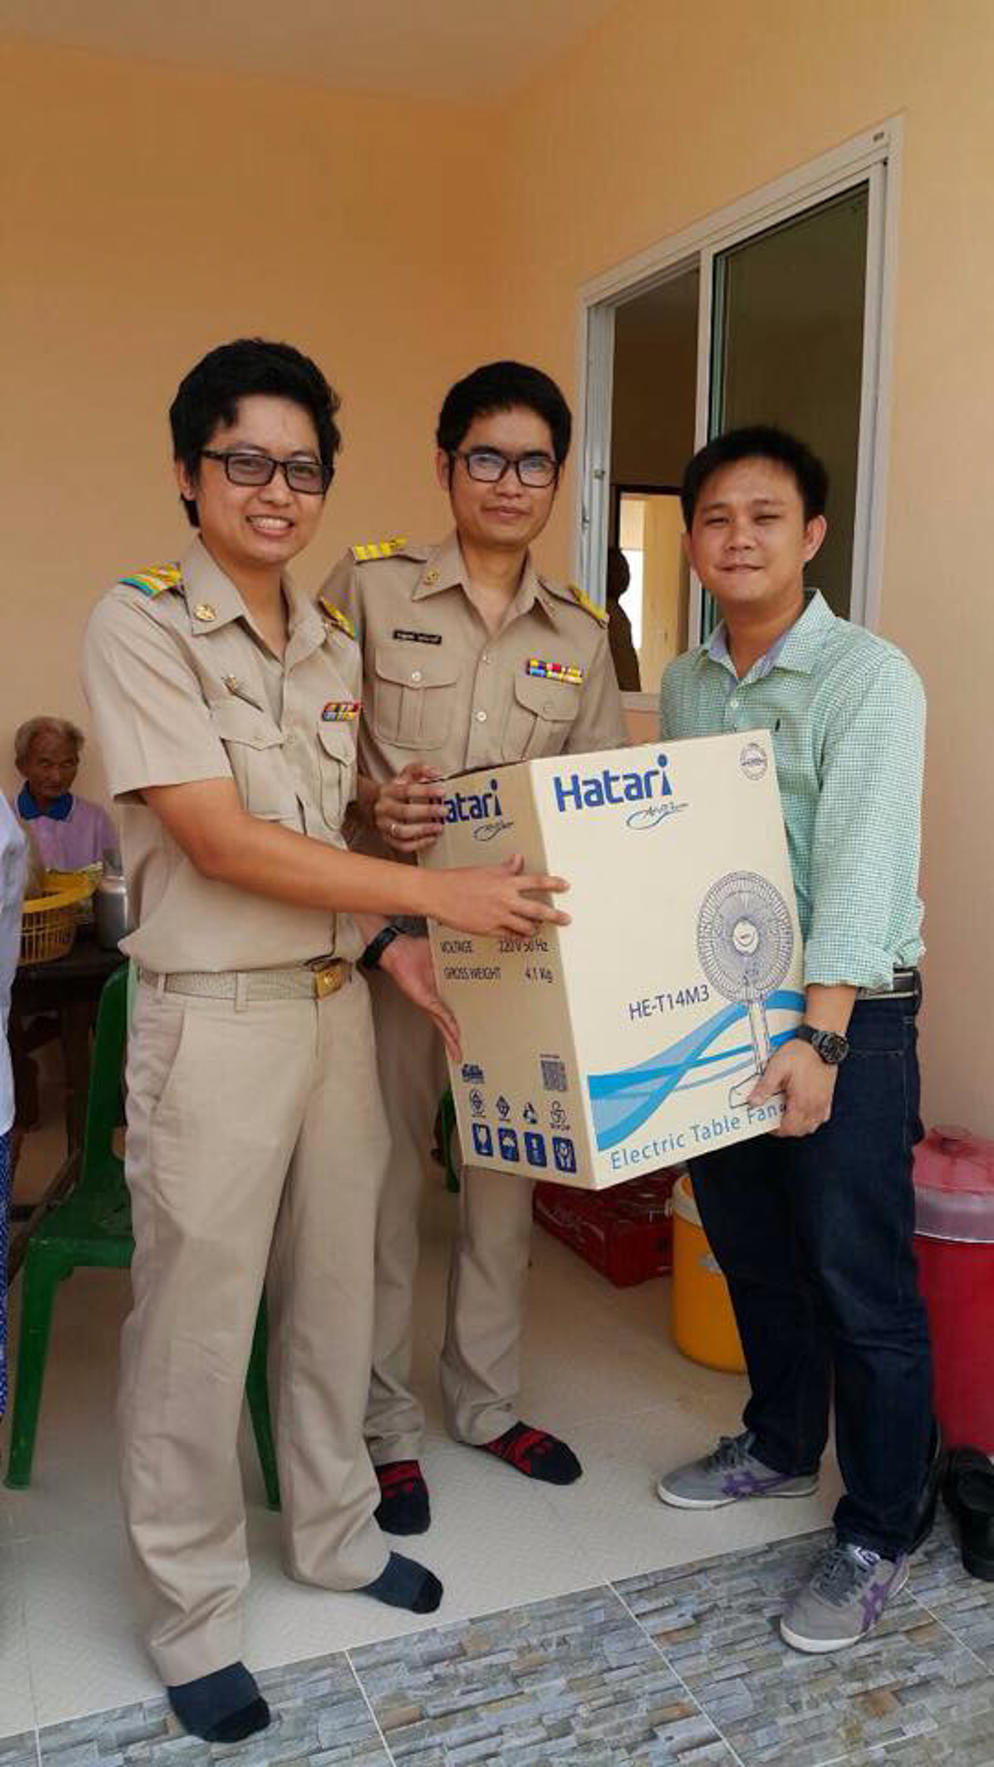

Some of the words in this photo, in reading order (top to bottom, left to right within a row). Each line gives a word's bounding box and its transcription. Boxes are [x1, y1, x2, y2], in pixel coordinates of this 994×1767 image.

[553, 753, 673, 813] Hatari
[440, 940, 473, 954] VOLTAGE
[628, 983, 710, 1021] HE-T14M3
[610, 1132, 686, 1171] Electric
[690, 1115, 742, 1143] Table
